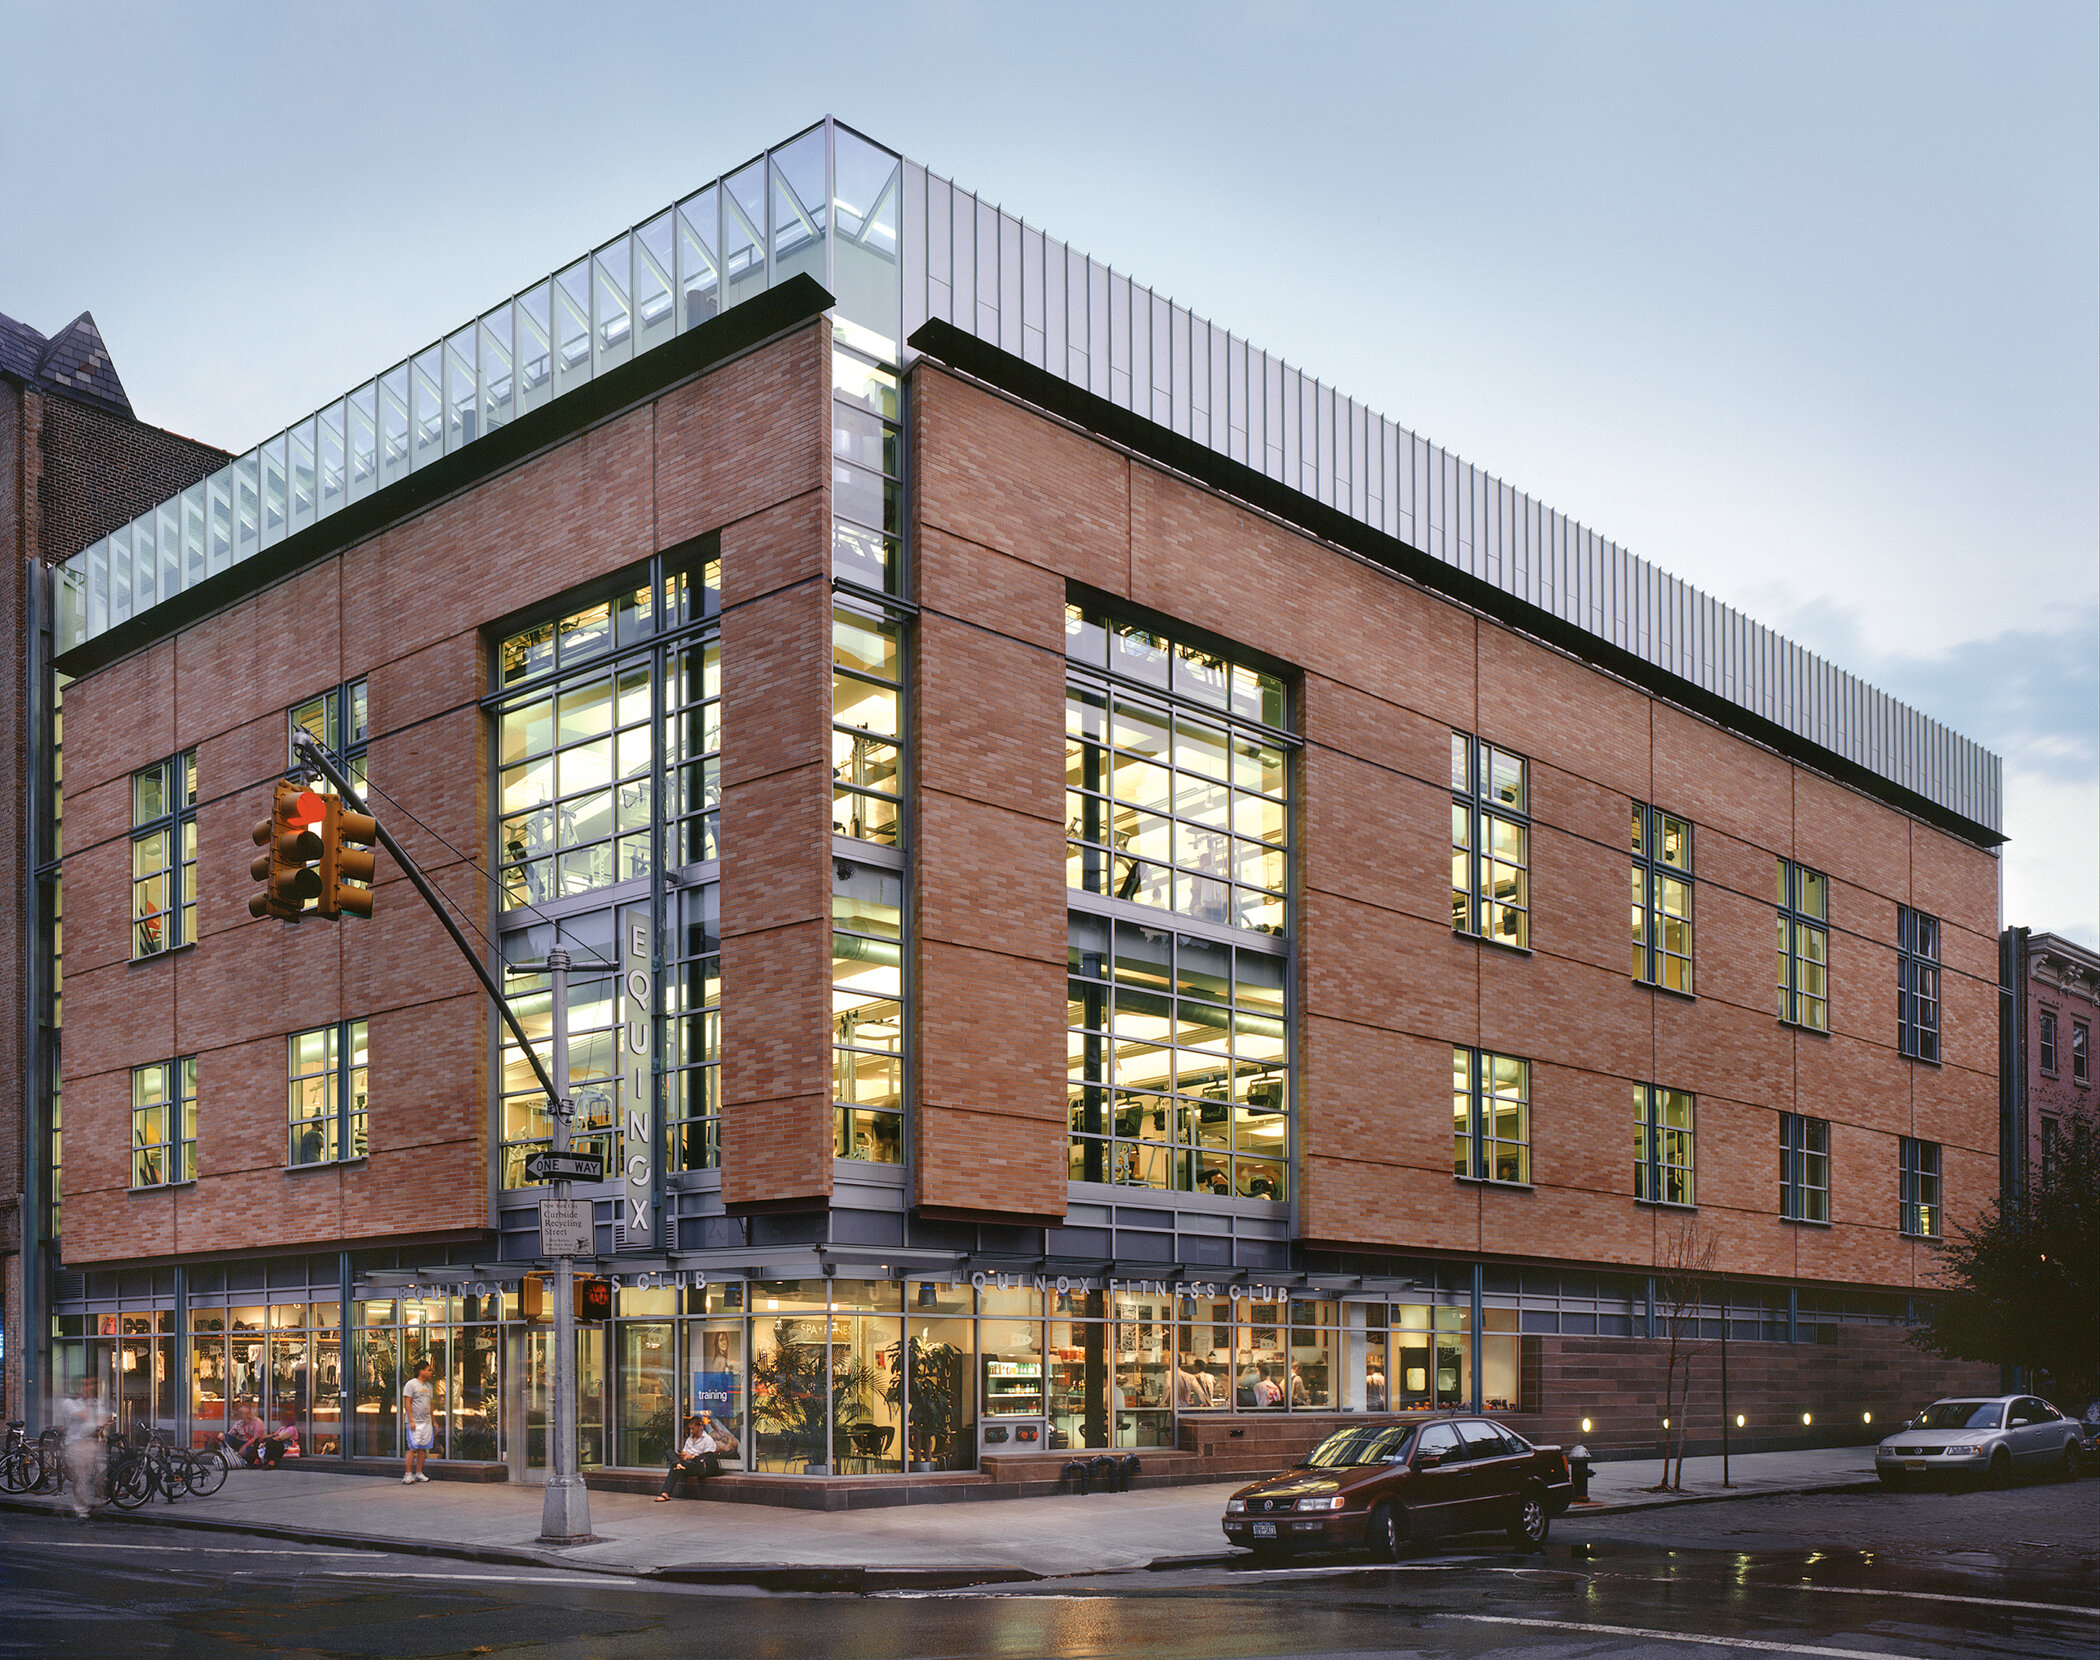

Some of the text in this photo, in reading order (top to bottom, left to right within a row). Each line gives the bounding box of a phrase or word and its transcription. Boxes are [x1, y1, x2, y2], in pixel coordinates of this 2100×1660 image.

[628, 924, 650, 1230] EQUINOX
[537, 1160, 598, 1174] ONE WAY
[544, 1211, 578, 1219] Curbside
[545, 1220, 582, 1228] Recycling
[545, 1228, 567, 1236] Street
[399, 1281, 504, 1305] EQUINOX
[637, 1271, 707, 1292] CLUB
[951, 1271, 1289, 1303] EQUINOX FITNESS CLUB
[800, 1324, 818, 1335] SPA
[698, 1390, 727, 1402] training
